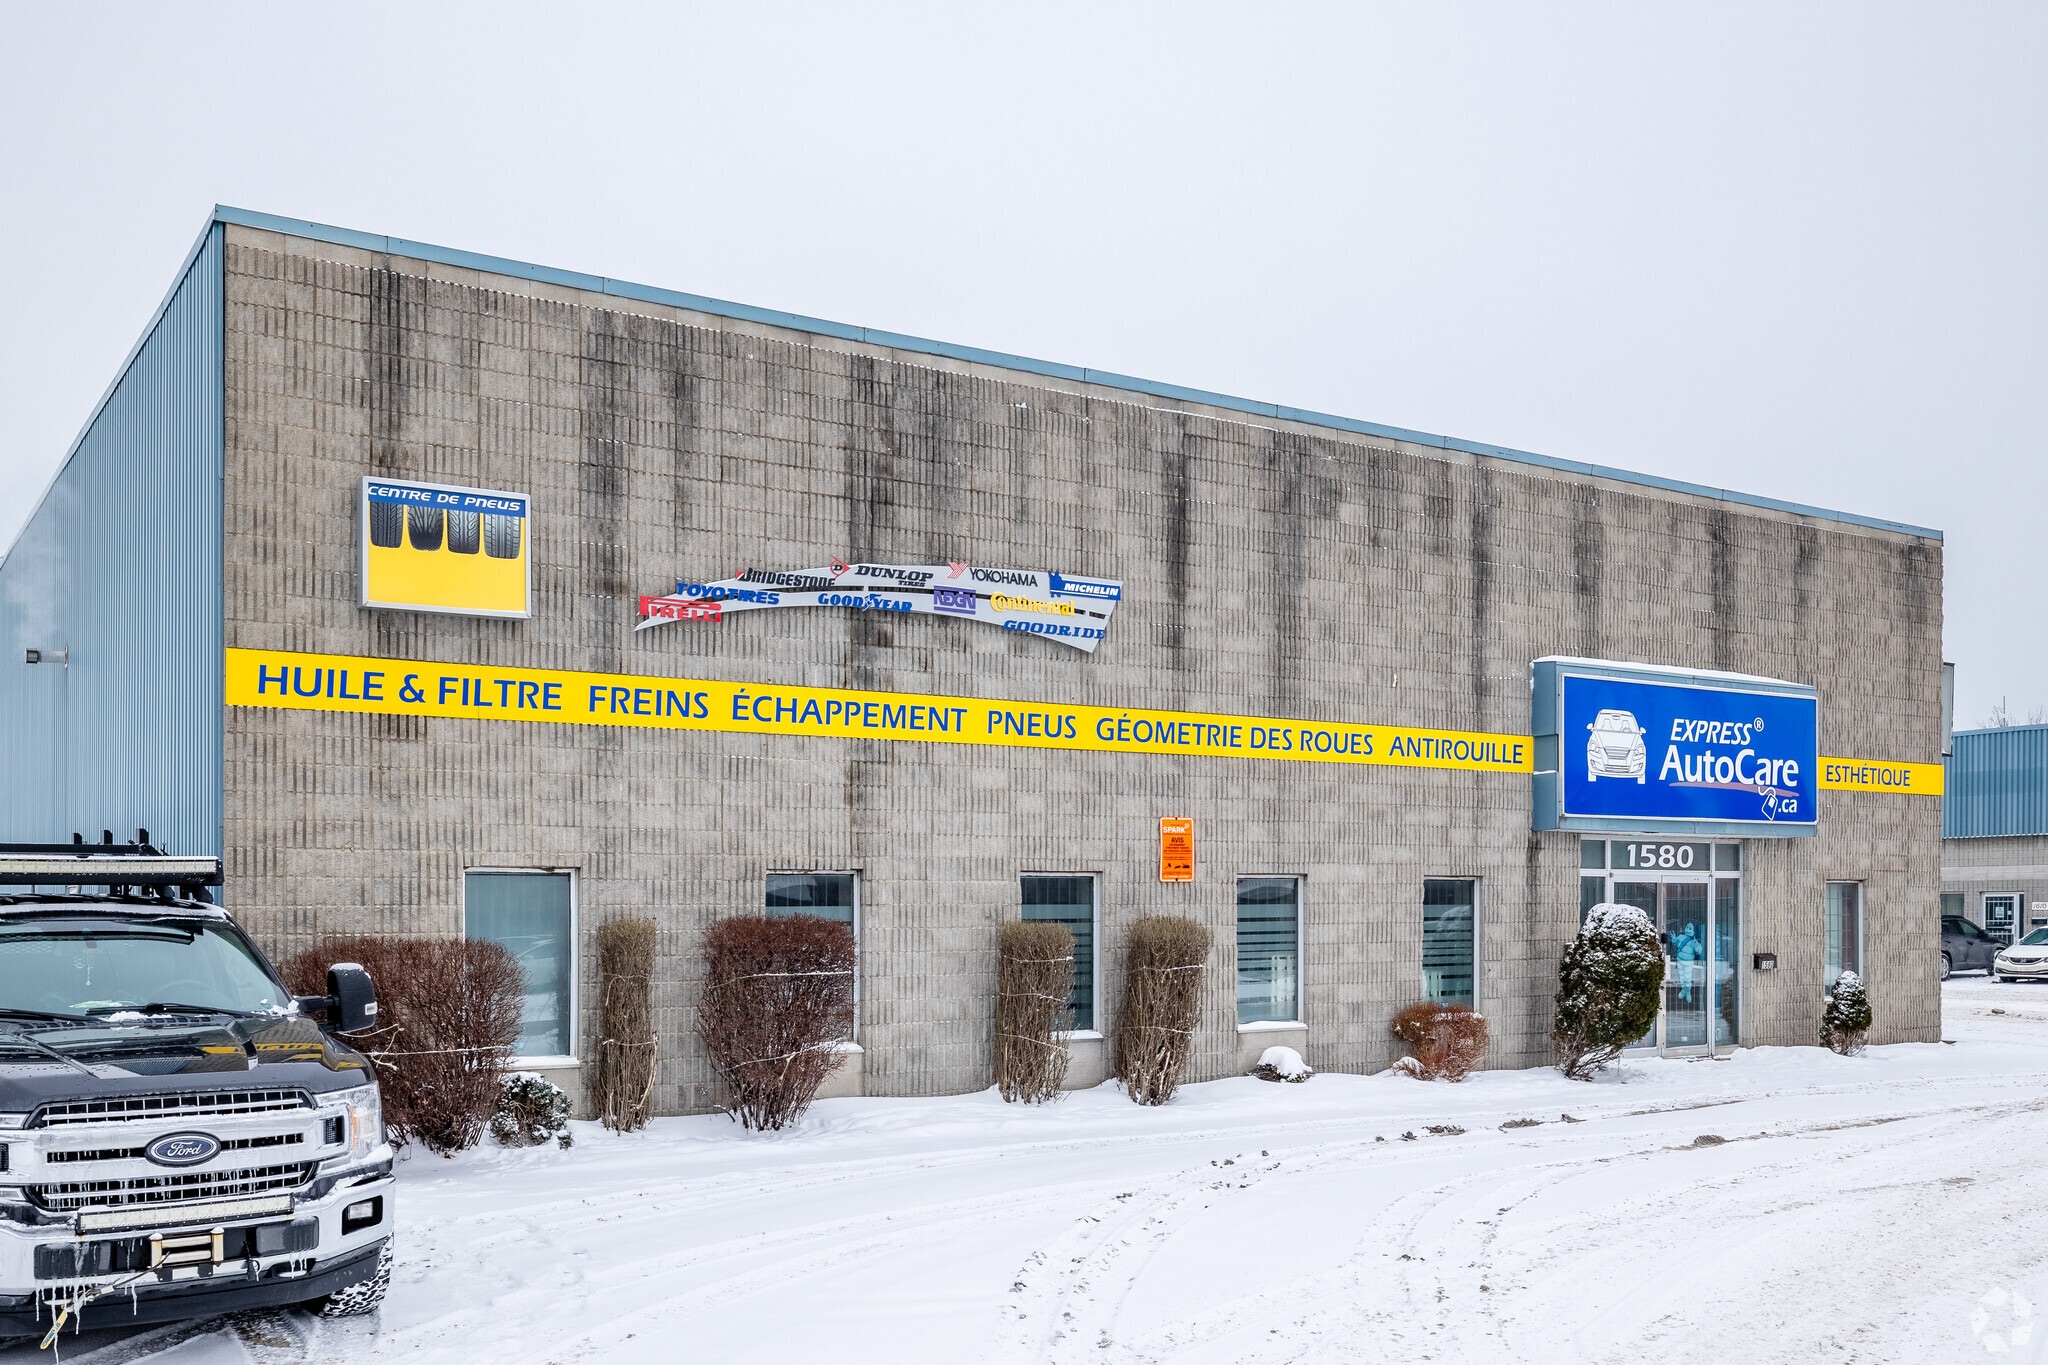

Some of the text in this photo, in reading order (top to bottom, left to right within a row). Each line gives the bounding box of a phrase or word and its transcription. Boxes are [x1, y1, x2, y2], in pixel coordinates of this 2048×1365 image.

[367, 485, 521, 512] CENTRE DE PNEUS
[739, 567, 836, 588] BRIDGESTONE
[855, 565, 934, 582] DUNLOP
[897, 580, 926, 588] TIRES
[969, 567, 1038, 588] YOKOHAMA
[676, 582, 780, 605] TOYO TIRES
[1063, 582, 1119, 597] MICHELIN
[639, 595, 722, 623] PIRELLI
[818, 593, 912, 613] GOODYEAR
[990, 591, 1075, 617] Continental
[1003, 620, 1105, 639] GOODRIDE
[257, 664, 1524, 764] HUILE & FILTRE FREINS ÉCHAPPEMENT PNEUS GÉOMETRIE DES ROUES ANTIROUILLE
[1659, 745, 1799, 787] AutoCare
[1825, 762, 1911, 787] ESTHÉTIQUE
[1627, 844, 1694, 868] 1580
[167, 1141, 203, 1157] Ford
